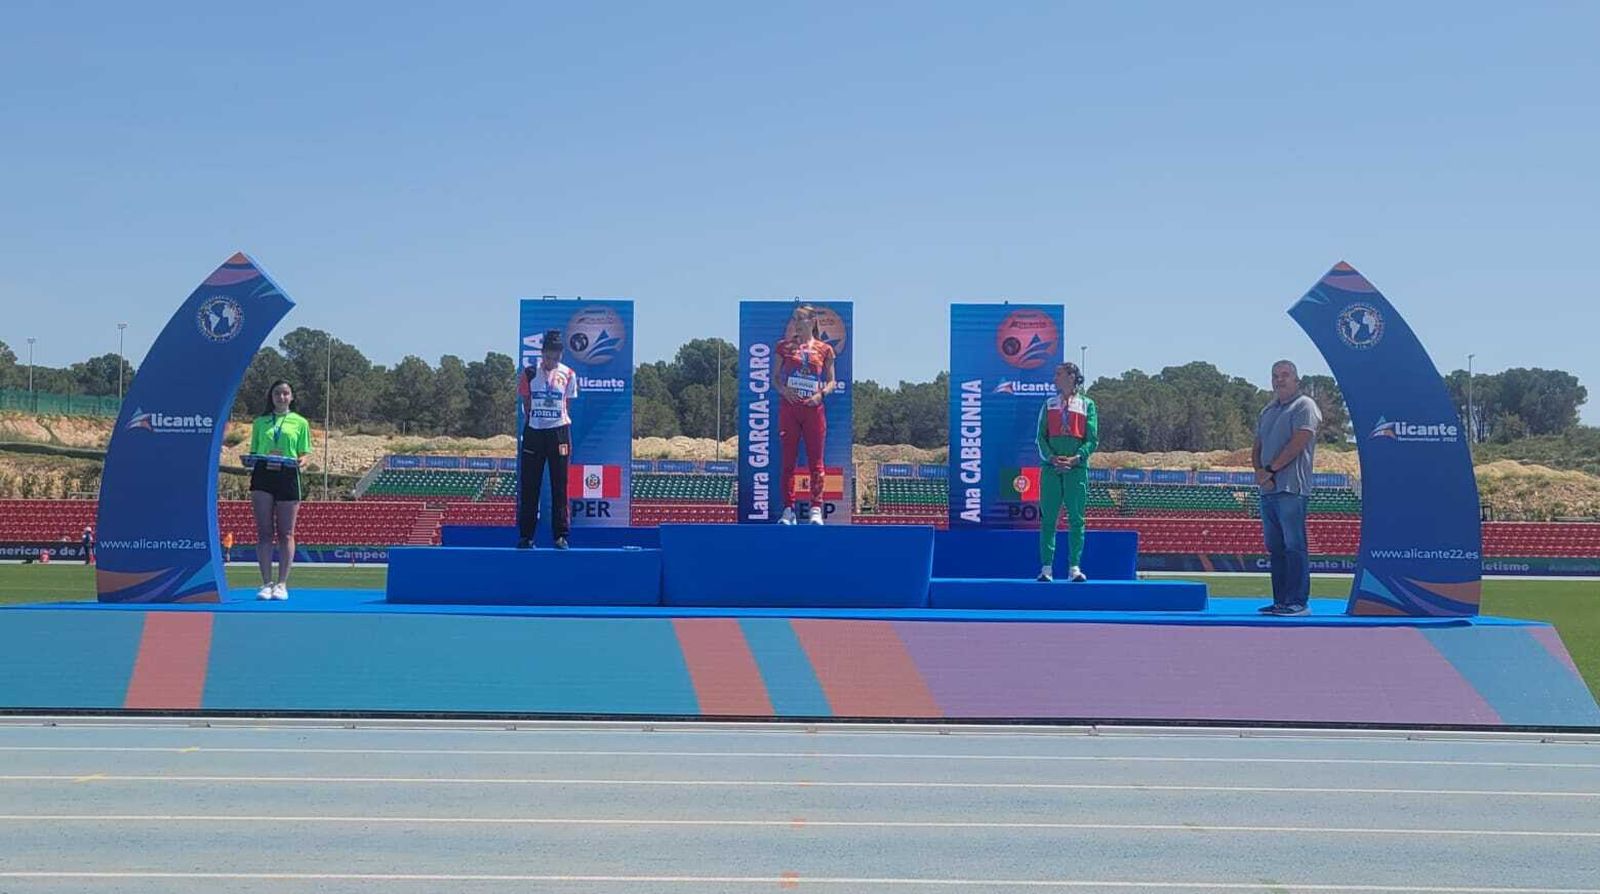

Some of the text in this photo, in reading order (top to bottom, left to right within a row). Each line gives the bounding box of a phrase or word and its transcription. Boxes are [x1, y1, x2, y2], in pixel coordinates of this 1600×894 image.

[522, 333, 544, 369] CIA
[748, 343, 770, 520] Laura GARCIA-CARO
[960, 379, 982, 522] Ana CABECINHA
[572, 501, 611, 518] PER
[799, 502, 836, 519] EP
[1008, 504, 1041, 521] PO
[60, 546, 76, 556] de
[100, 539, 207, 549] www.alicante22.es
[334, 549, 389, 559] Campeo
[1370, 548, 1479, 559] www.alicante22.es
[1481, 561, 1529, 571] letismo
